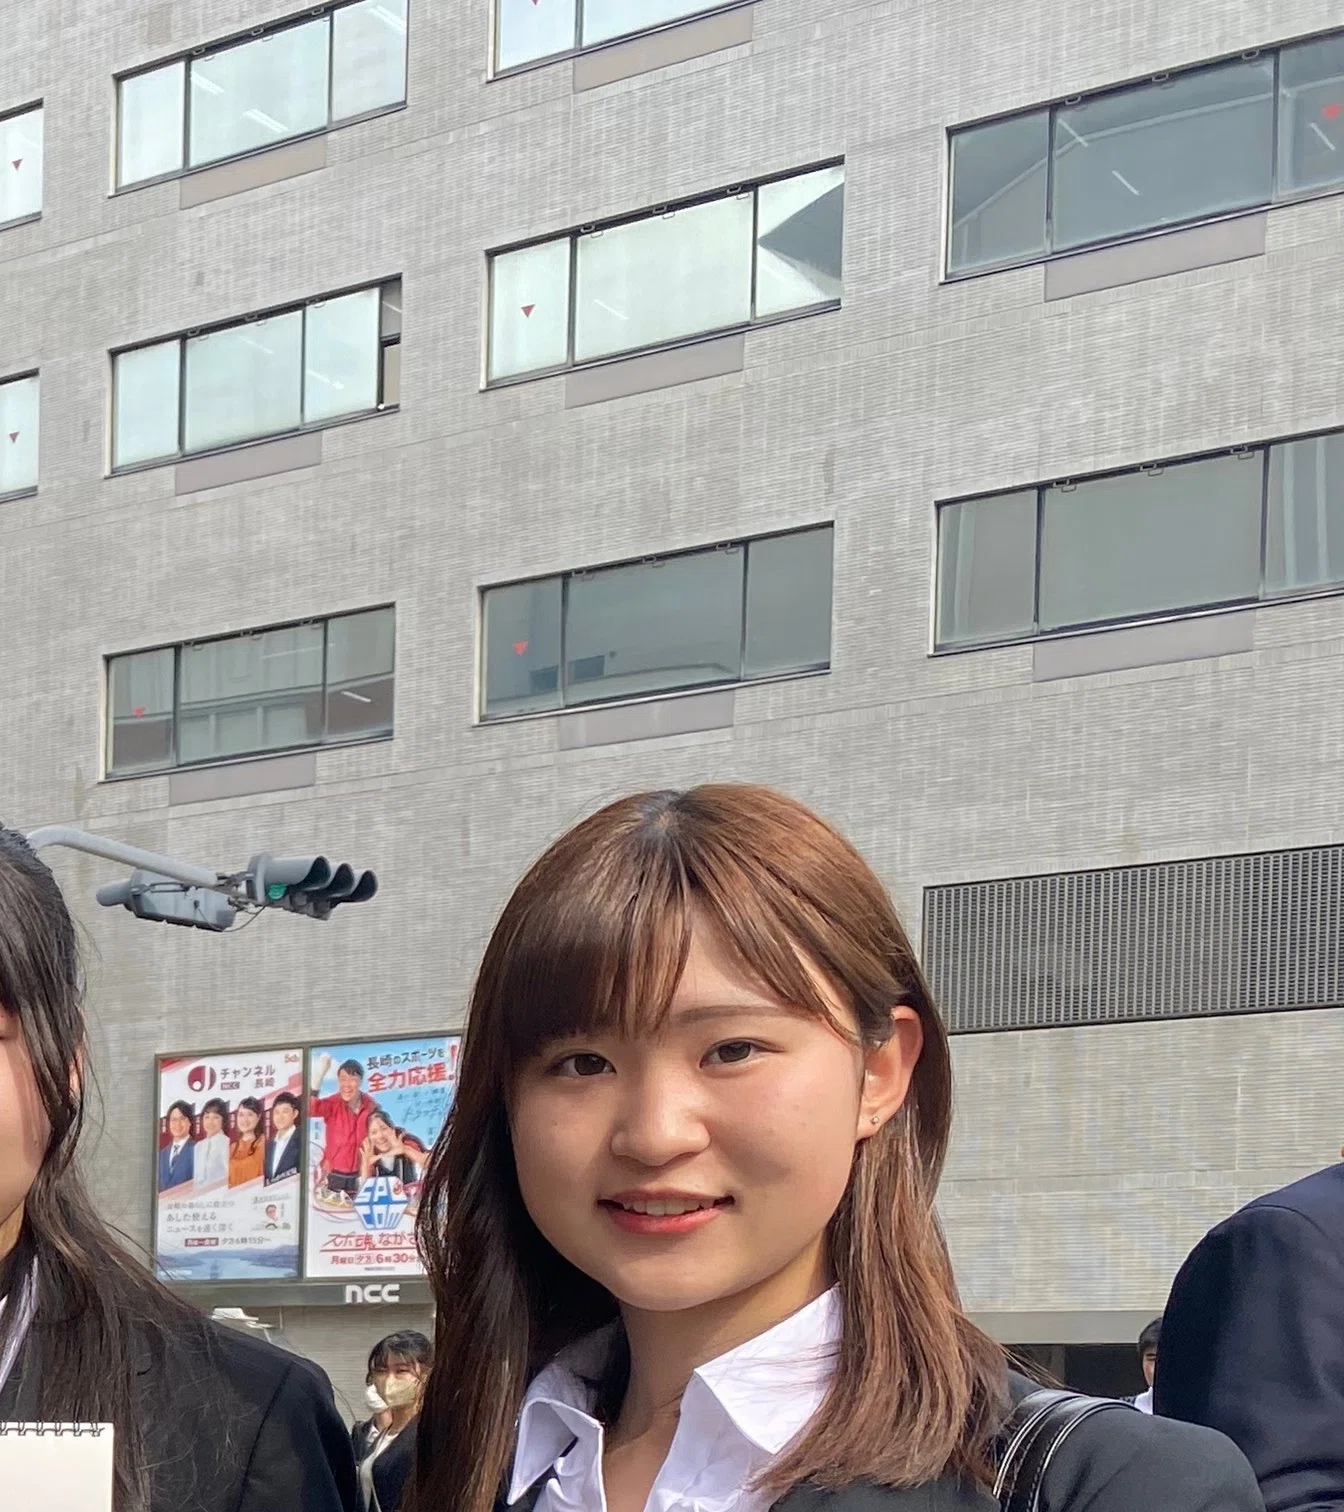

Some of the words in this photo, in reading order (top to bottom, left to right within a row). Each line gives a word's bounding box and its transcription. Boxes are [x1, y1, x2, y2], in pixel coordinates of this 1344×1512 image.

[366, 1047, 445, 1070] 長崎のスポーツを
[220, 1065, 276, 1080] チャンネル
[322, 1230, 416, 1251] スポ魂ながさ
[330, 1253, 418, 1266] 月曜日夕方6時30分
